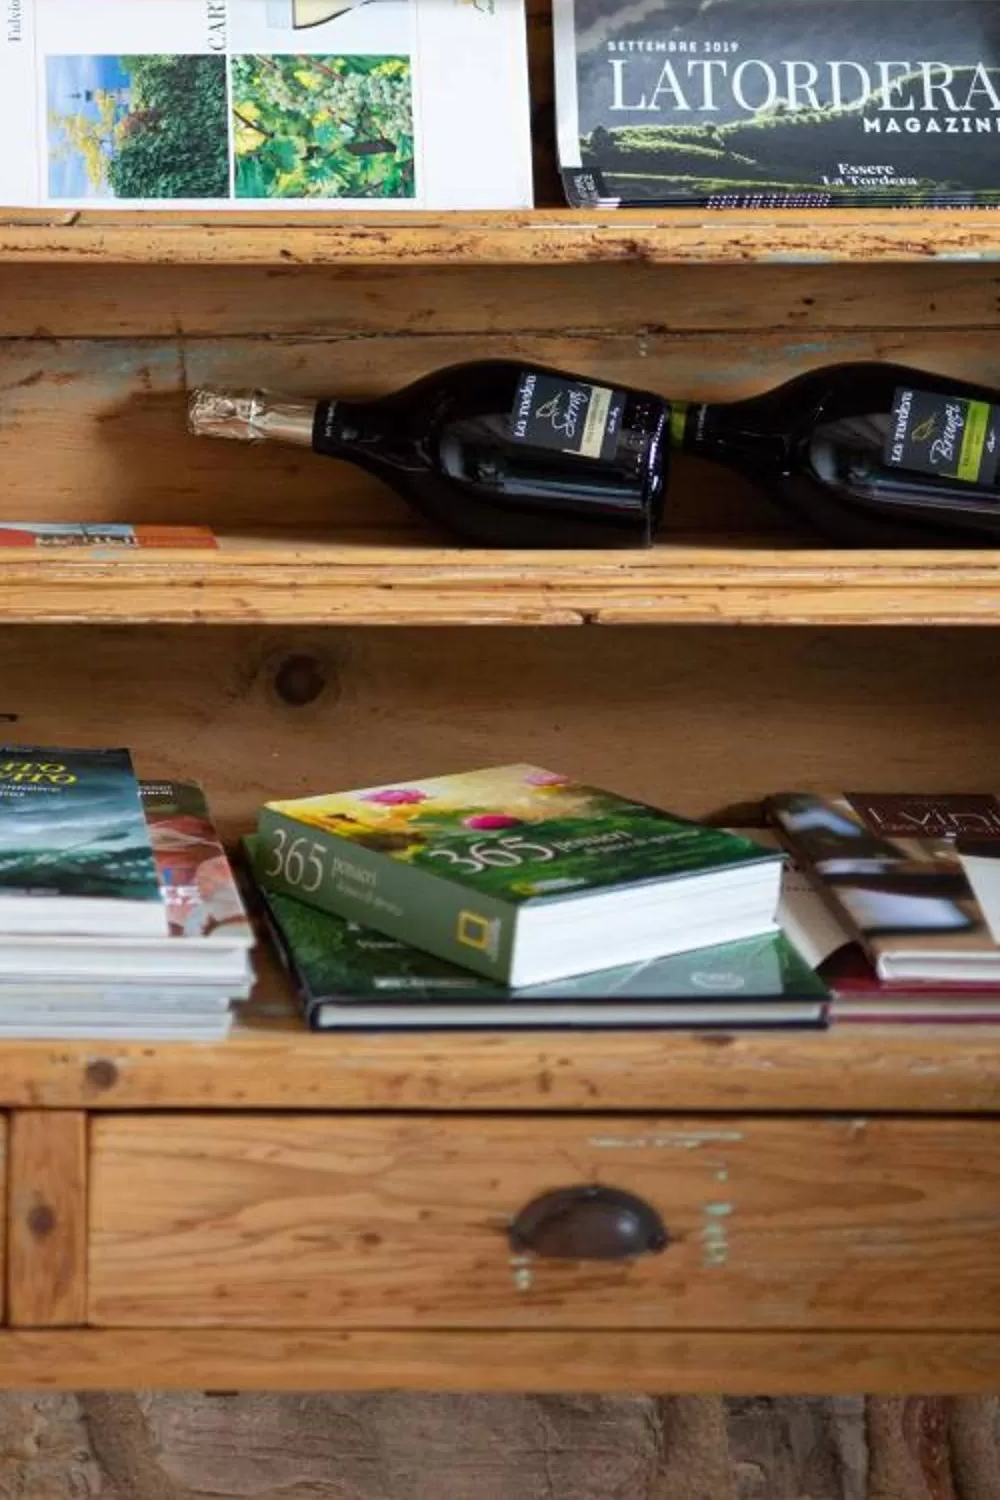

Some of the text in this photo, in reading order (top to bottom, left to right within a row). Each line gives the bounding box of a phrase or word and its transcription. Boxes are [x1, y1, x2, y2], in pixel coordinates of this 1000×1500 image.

[607, 40, 740, 53] SETTEMBRE 2019
[837, 163, 895, 175] Essere
[821, 175, 919, 186] La Tordera
[265, 828, 328, 893] 365
[427, 835, 555, 874] 365
